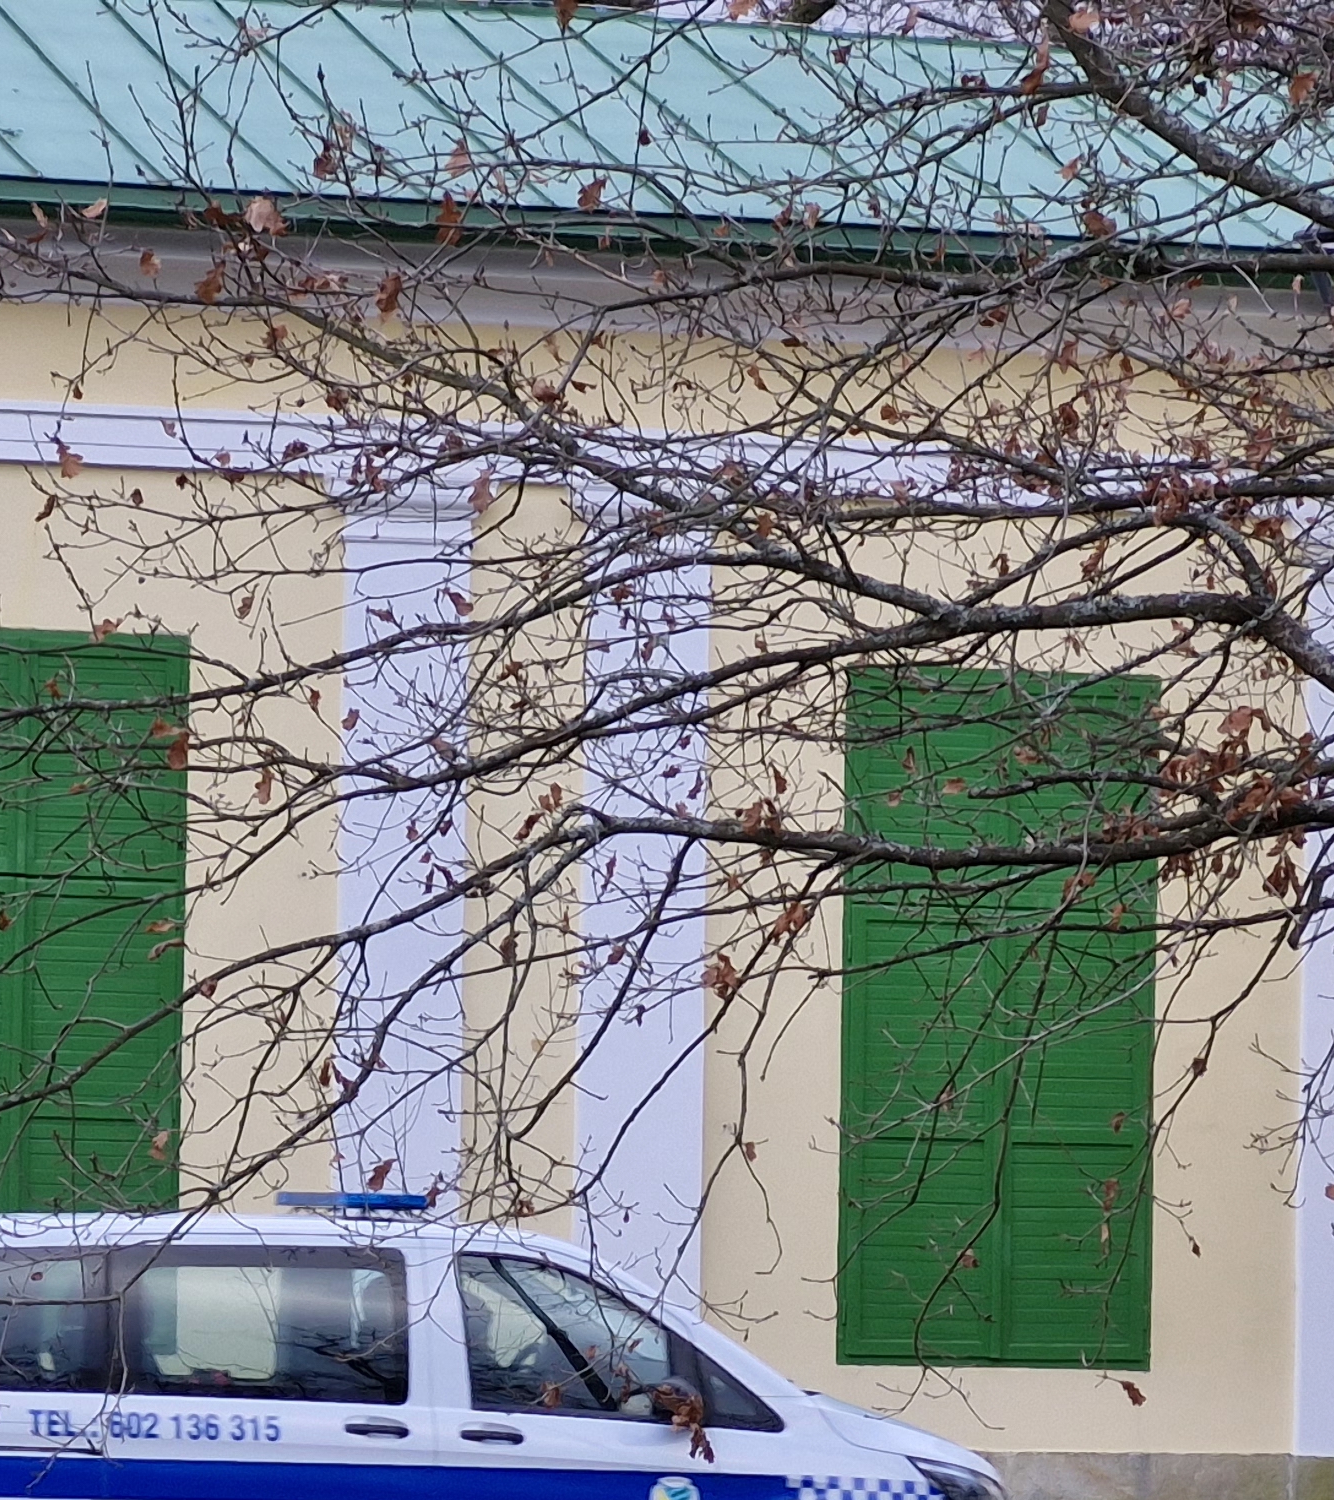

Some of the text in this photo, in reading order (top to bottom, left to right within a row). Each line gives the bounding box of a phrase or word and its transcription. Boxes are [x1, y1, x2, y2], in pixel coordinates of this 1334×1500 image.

[109, 1412, 160, 1439] 602
[169, 1413, 220, 1441] 136
[229, 1414, 281, 1442] 315
